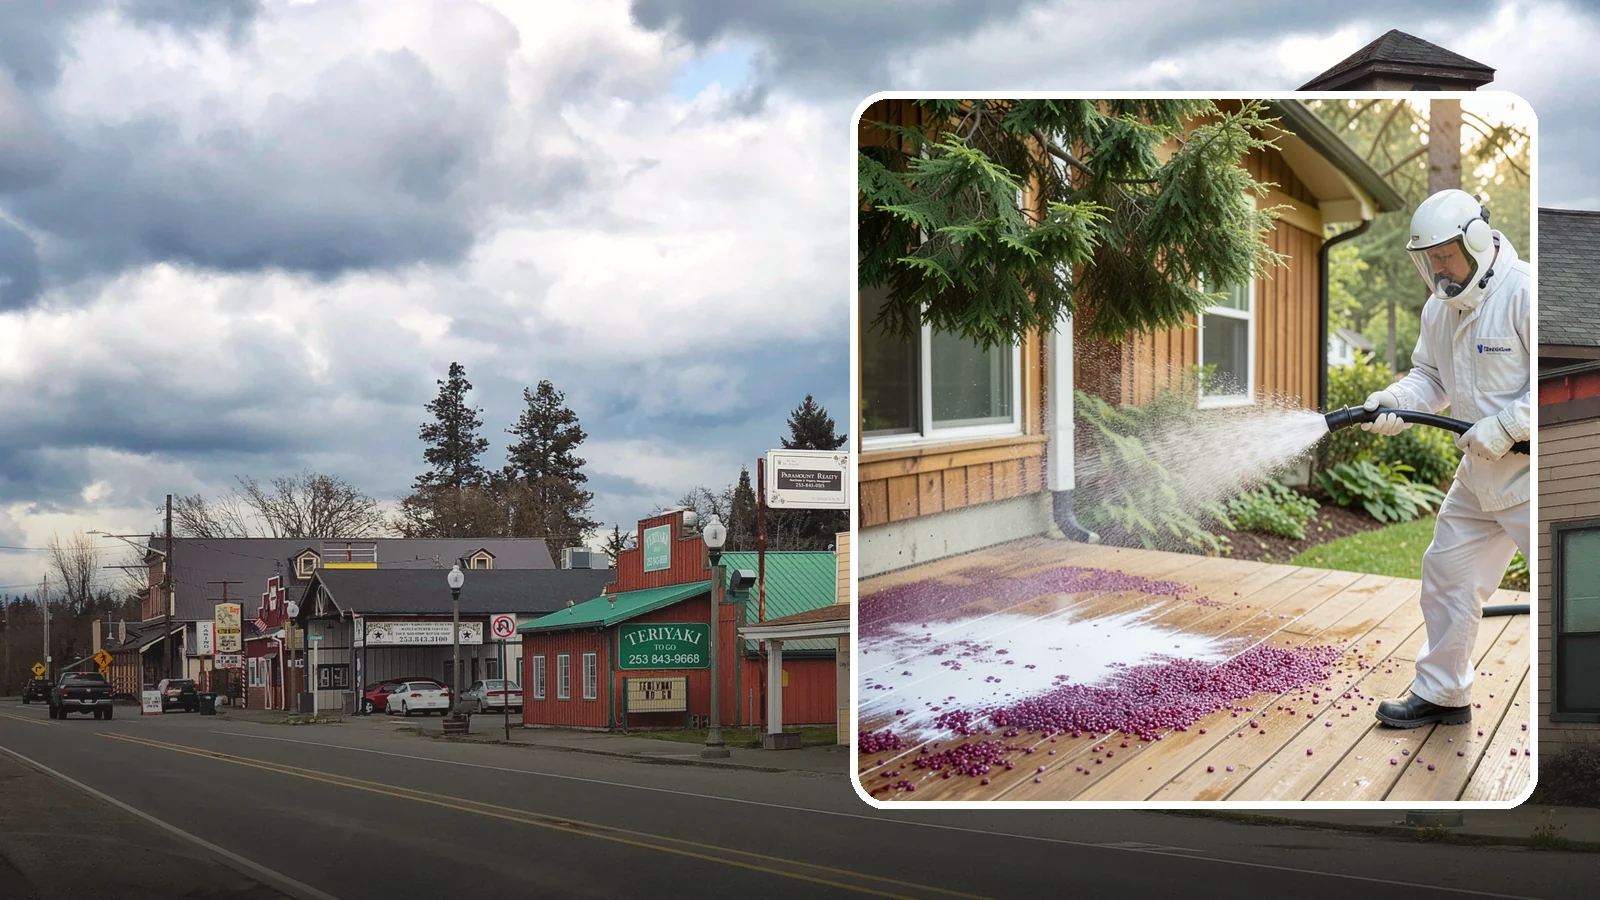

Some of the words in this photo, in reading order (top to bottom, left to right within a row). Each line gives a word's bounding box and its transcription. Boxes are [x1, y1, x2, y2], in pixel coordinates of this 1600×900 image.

[781, 471, 814, 479] PARAMOUNT
[624, 627, 702, 646] TERIYAKI
[629, 654, 649, 664] 253
[652, 654, 700, 664] 843-9668
